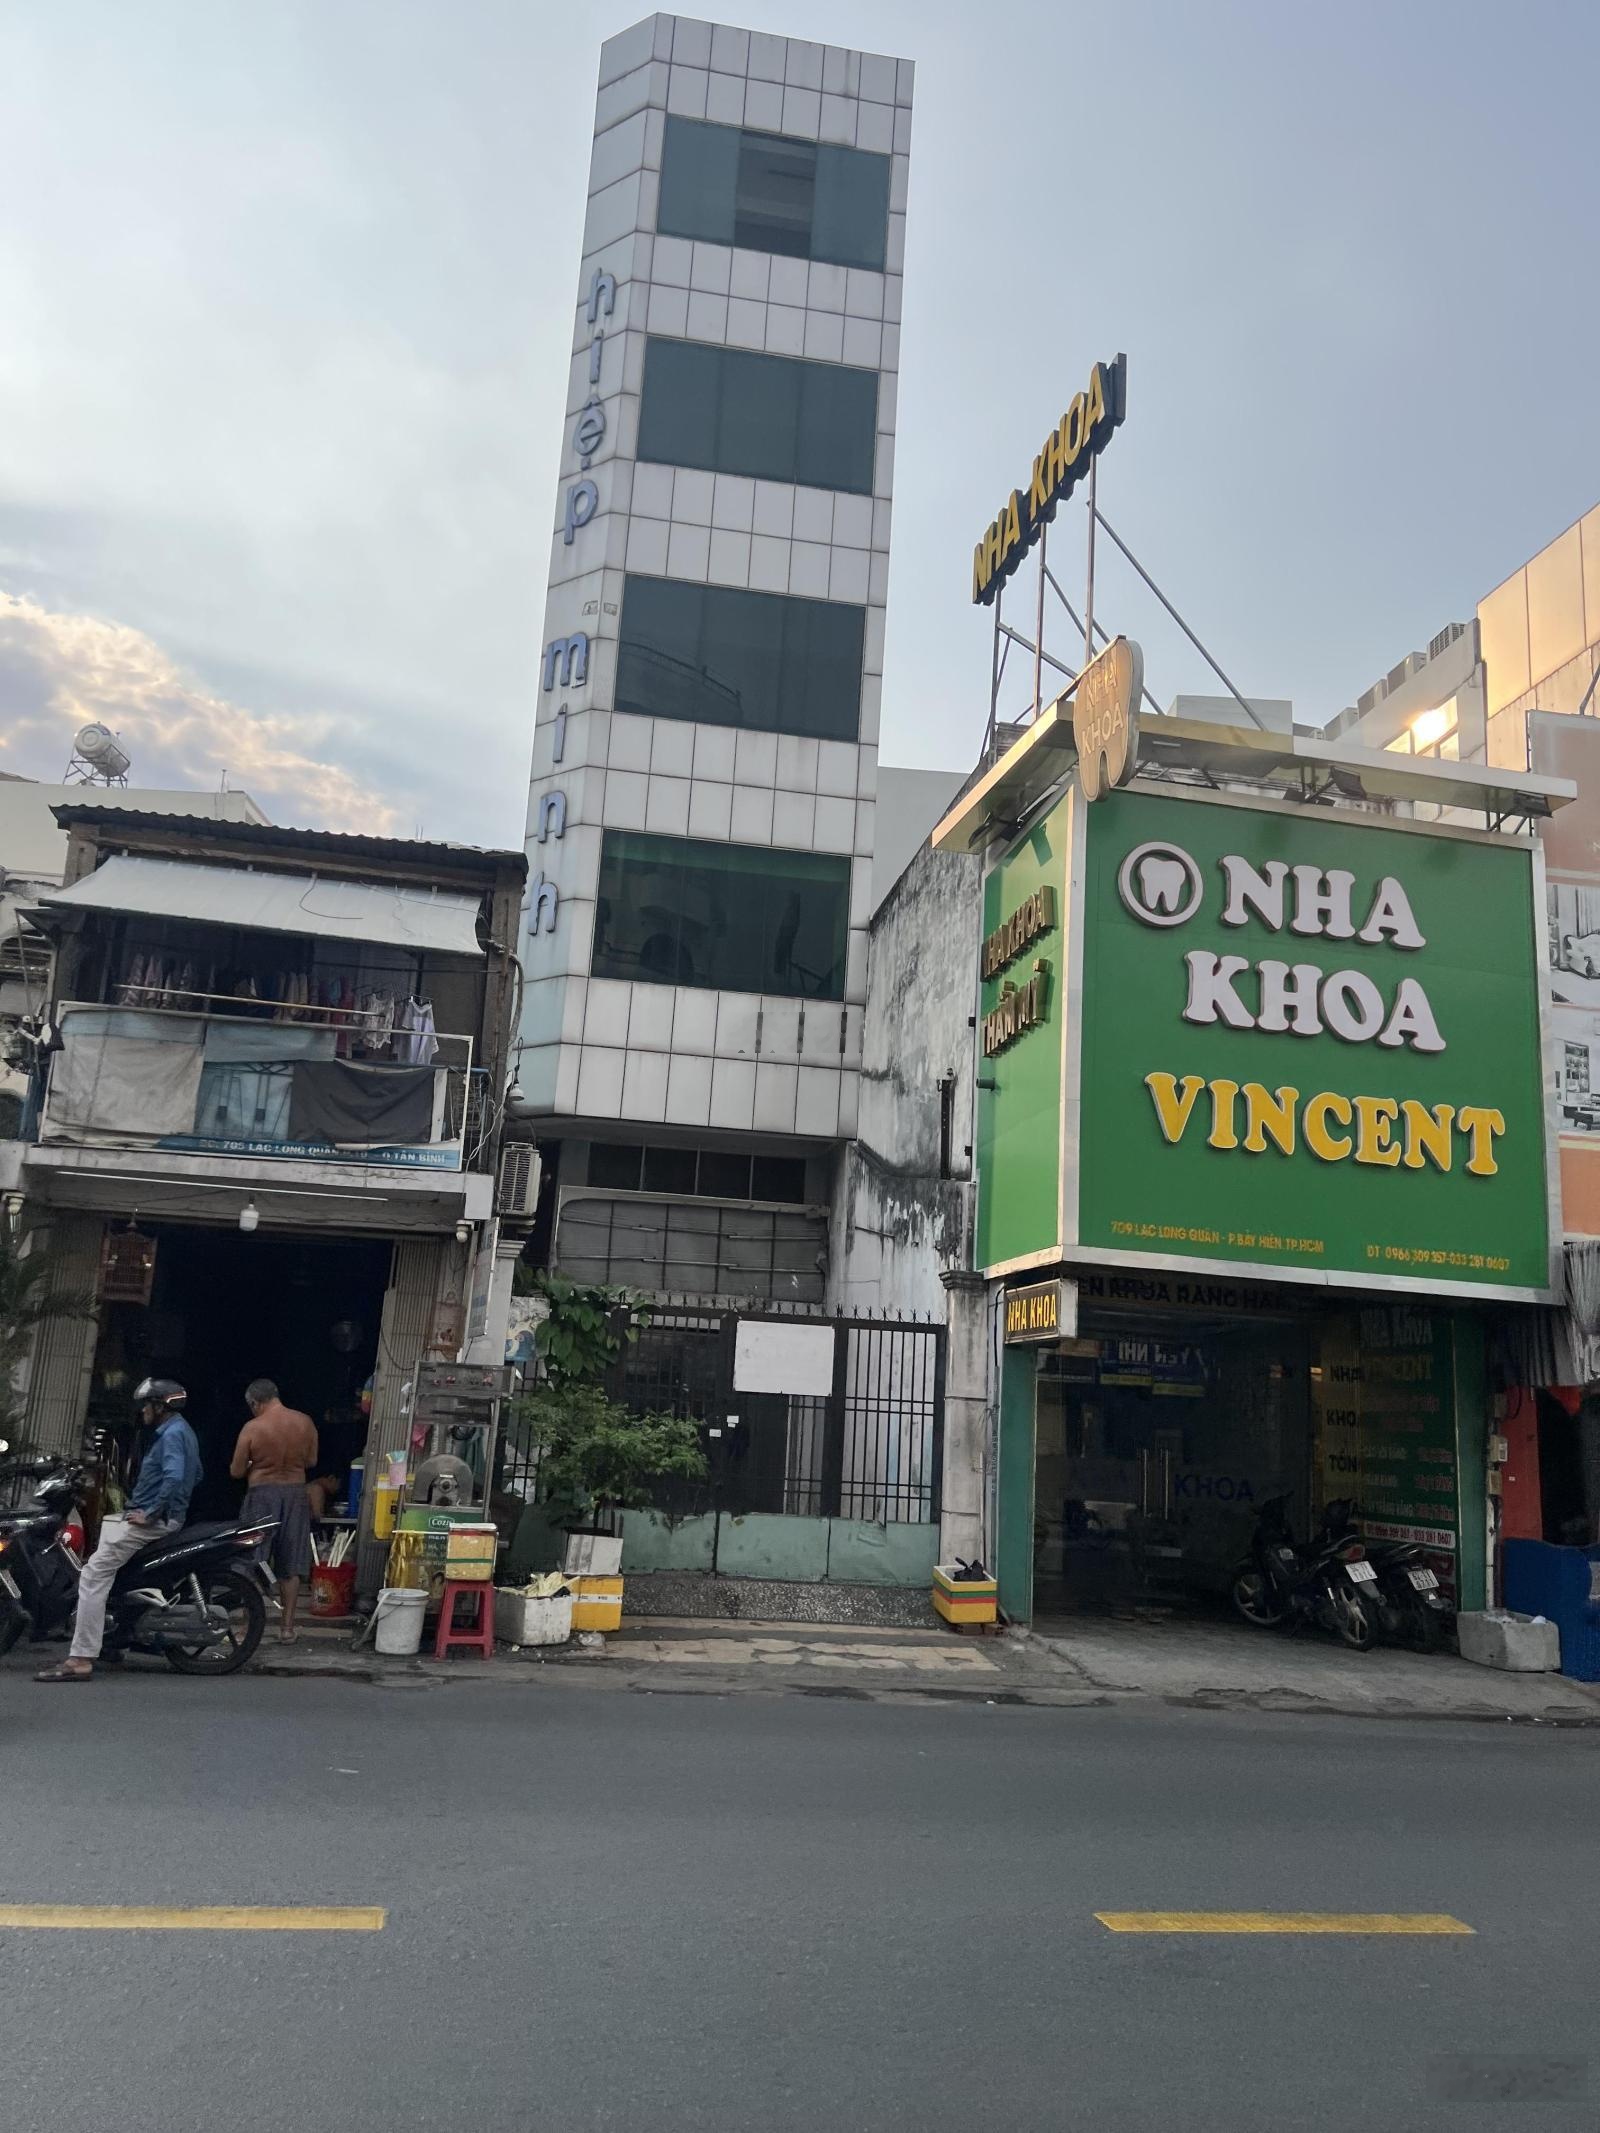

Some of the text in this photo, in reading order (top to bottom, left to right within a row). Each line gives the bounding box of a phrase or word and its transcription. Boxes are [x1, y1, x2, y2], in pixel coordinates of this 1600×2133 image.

[972, 362, 1106, 602] NHA KHOA
[1081, 702, 1124, 758] KHOA
[1218, 854, 1427, 950] NHA
[1182, 950, 1447, 1053] KHOA
[1144, 1072, 1506, 1177] VINCENT
[275, 1145, 305, 1156] LONG
[1158, 1226, 1186, 1241] LONG
[1008, 1294, 1057, 1332] NHA KHOA
[1327, 1409, 1360, 1426] KHO
[1175, 1474, 1254, 1501] KHOA
